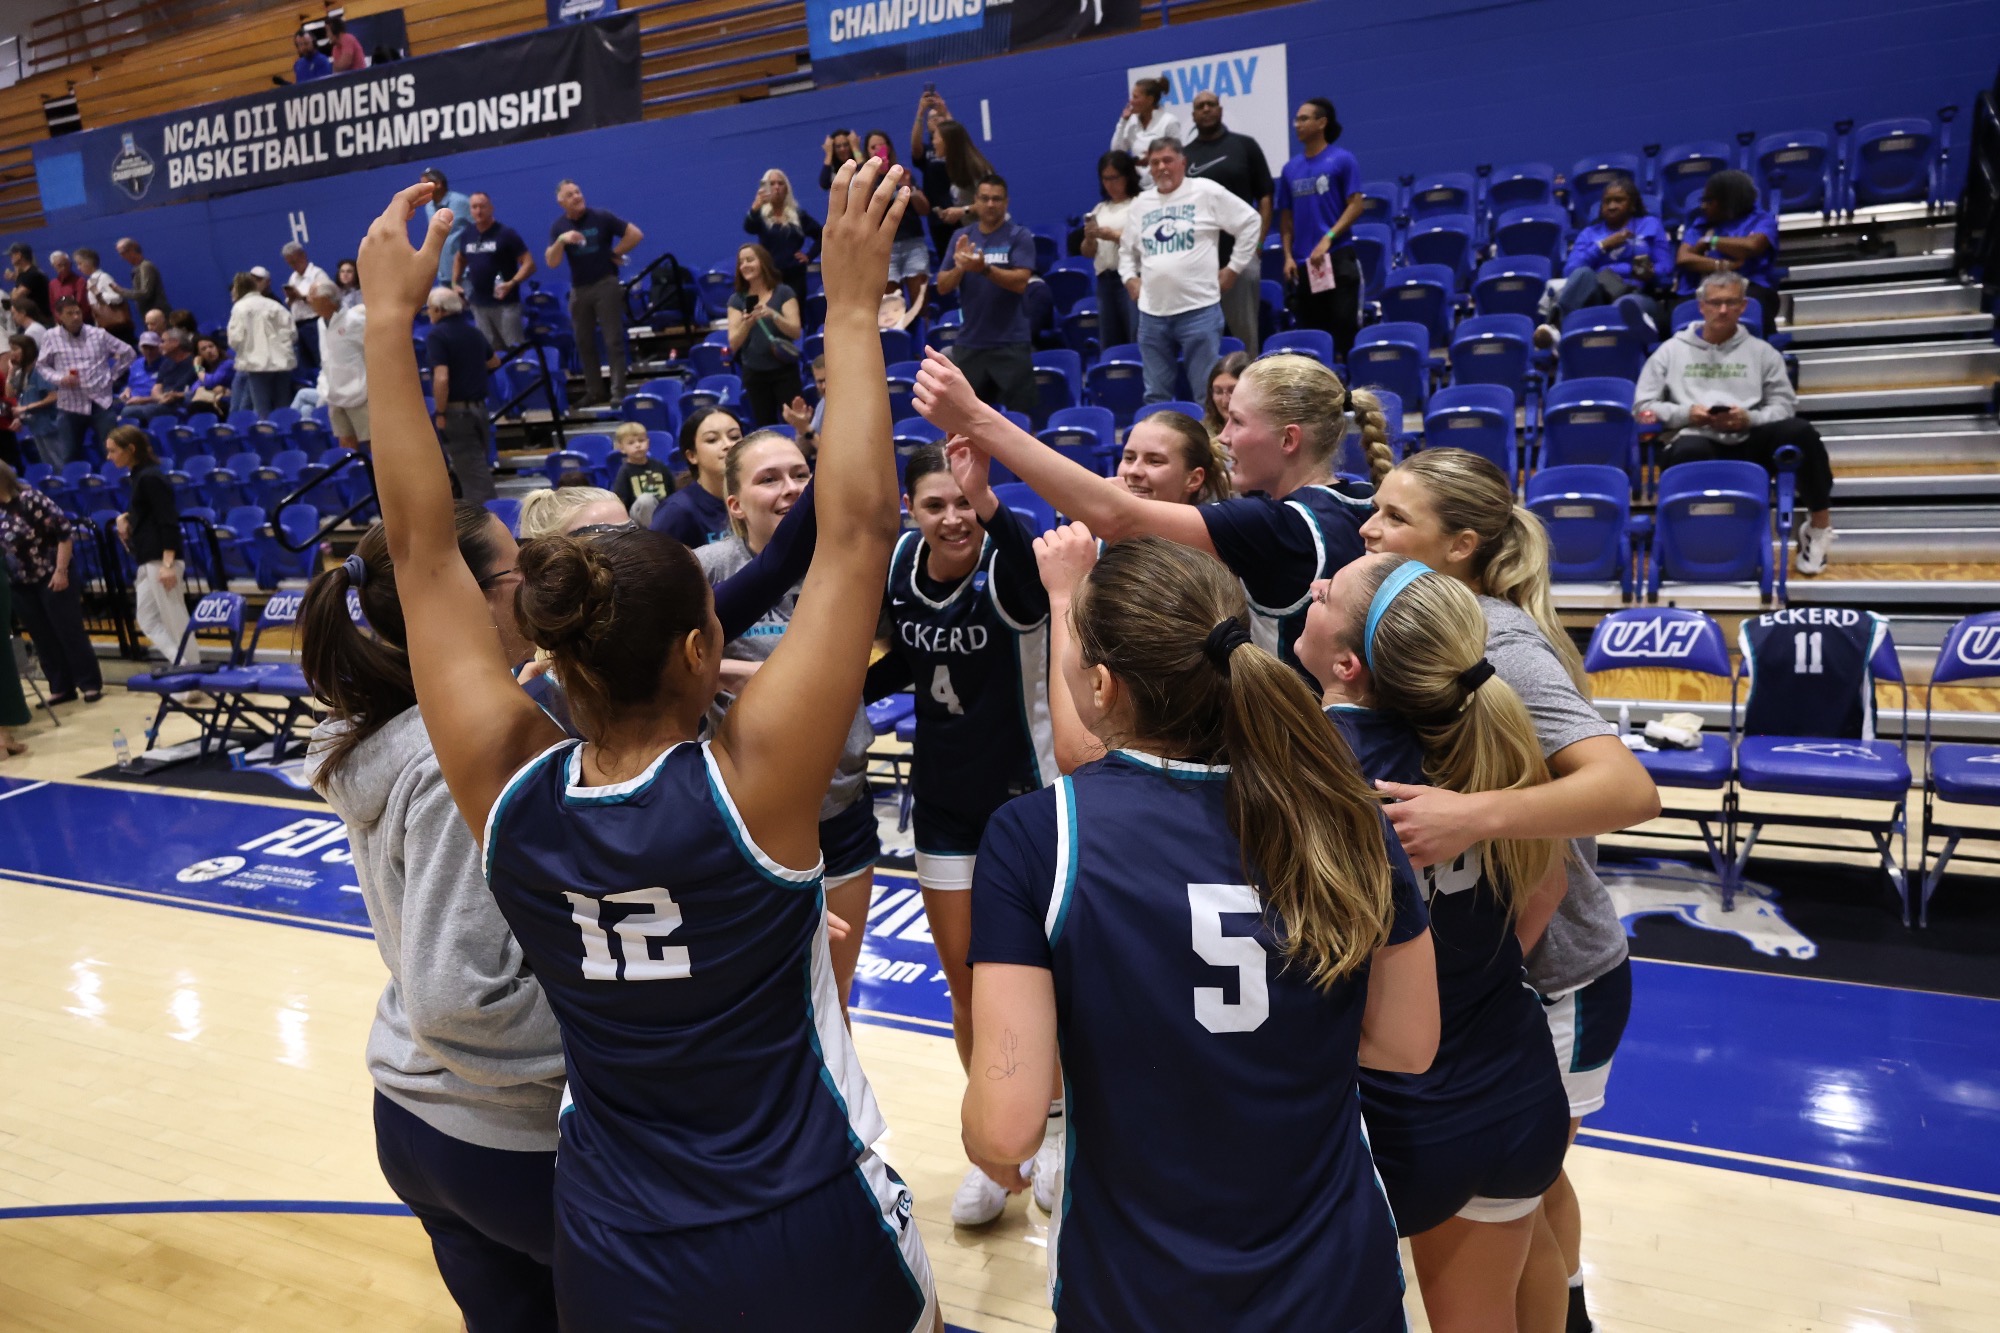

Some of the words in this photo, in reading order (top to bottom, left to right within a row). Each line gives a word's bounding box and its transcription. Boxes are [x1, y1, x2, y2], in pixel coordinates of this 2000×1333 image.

[830, 0, 982, 43] CHAMPIONS
[1160, 56, 1258, 106] AWAY
[163, 114, 229, 155] NCAA
[234, 102, 278, 141] DII
[284, 73, 416, 131] WOMEN'S
[168, 130, 329, 189] BASKETBALL
[335, 80, 582, 158] CHAMPIONSHIP
[288, 211, 309, 243] H
[194, 594, 233, 622] UAH
[1759, 608, 1860, 628] ECKERD
[745, 625, 784, 636] OMENS
[897, 620, 988, 655] CKERD
[1602, 616, 1707, 657] UAH
[1794, 631, 1824, 674] 11
[930, 665, 965, 715] 4
[561, 887, 693, 981] 12
[1187, 883, 1270, 1034] 5
